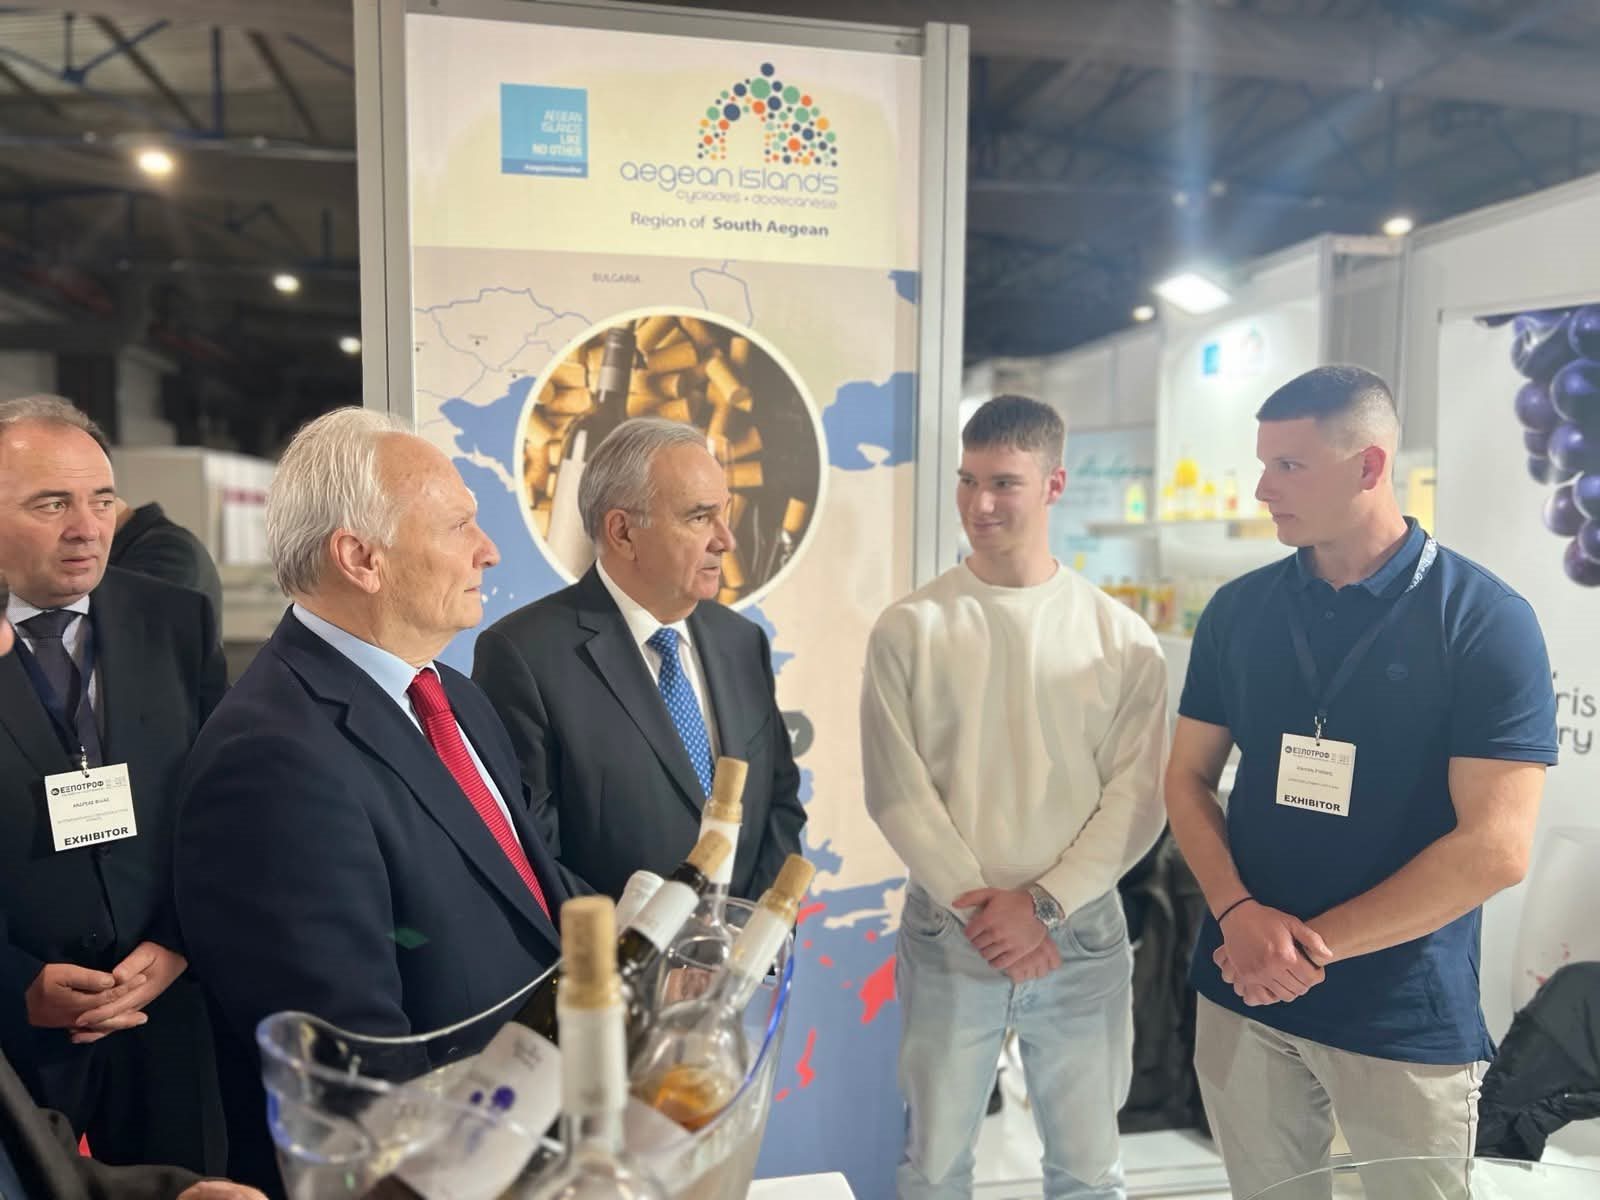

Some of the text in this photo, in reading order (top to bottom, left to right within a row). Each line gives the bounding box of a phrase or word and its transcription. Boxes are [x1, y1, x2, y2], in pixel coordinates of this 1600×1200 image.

[620, 161, 839, 195] aegean islands
[676, 189, 838, 210] cyclades dodecanese
[631, 211, 829, 238] Region of South Aegean
[592, 272, 641, 283] BULGARIA
[1284, 794, 1341, 812] EXHIBITOR
[64, 827, 129, 846] EXHIBITOR
